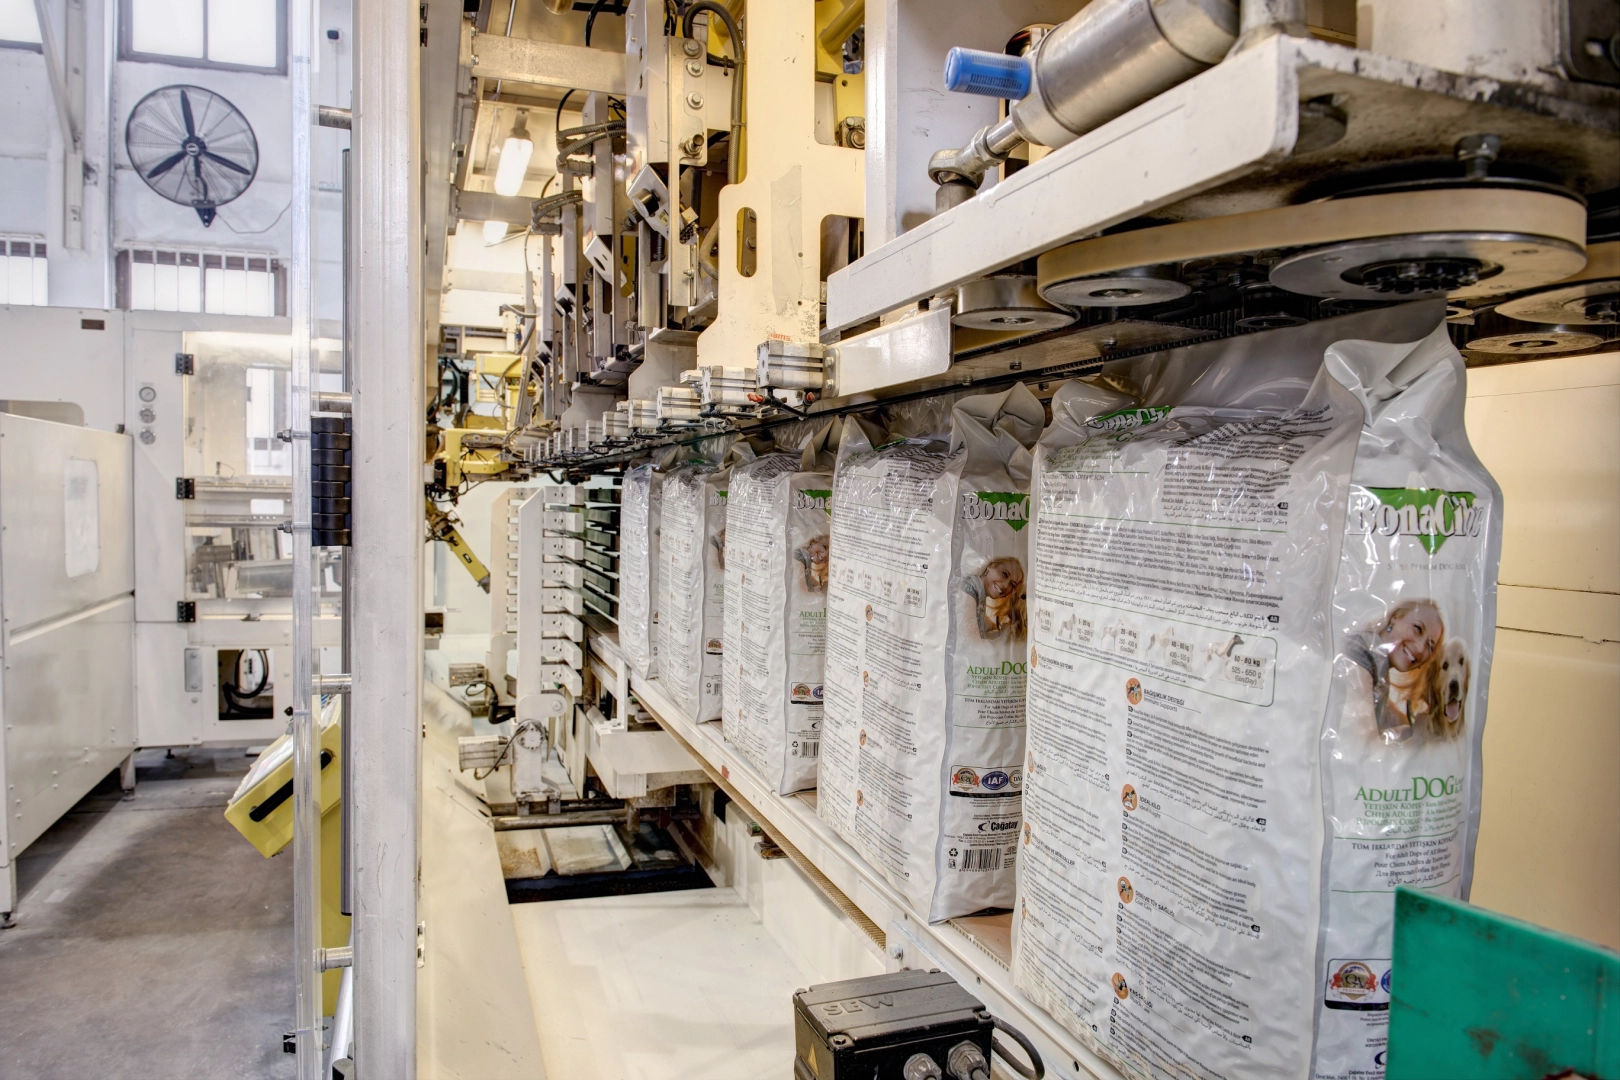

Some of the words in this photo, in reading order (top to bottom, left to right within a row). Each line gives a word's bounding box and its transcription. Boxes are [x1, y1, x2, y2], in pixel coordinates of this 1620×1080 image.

[1253, 658, 1260, 667] kg
[966, 664, 1000, 676] ADULT
[1231, 666, 1241, 674] 525
[1244, 669, 1256, 677] 650
[1257, 671, 1262, 679] g
[988, 776, 1004, 785] IAF
[1354, 785, 1412, 802] ADULT
[1411, 774, 1456, 801] DOG
[1364, 809, 1391, 818] CHIEN
[1351, 842, 1370, 850] TÜM
[823, 994, 895, 1016] SEW
